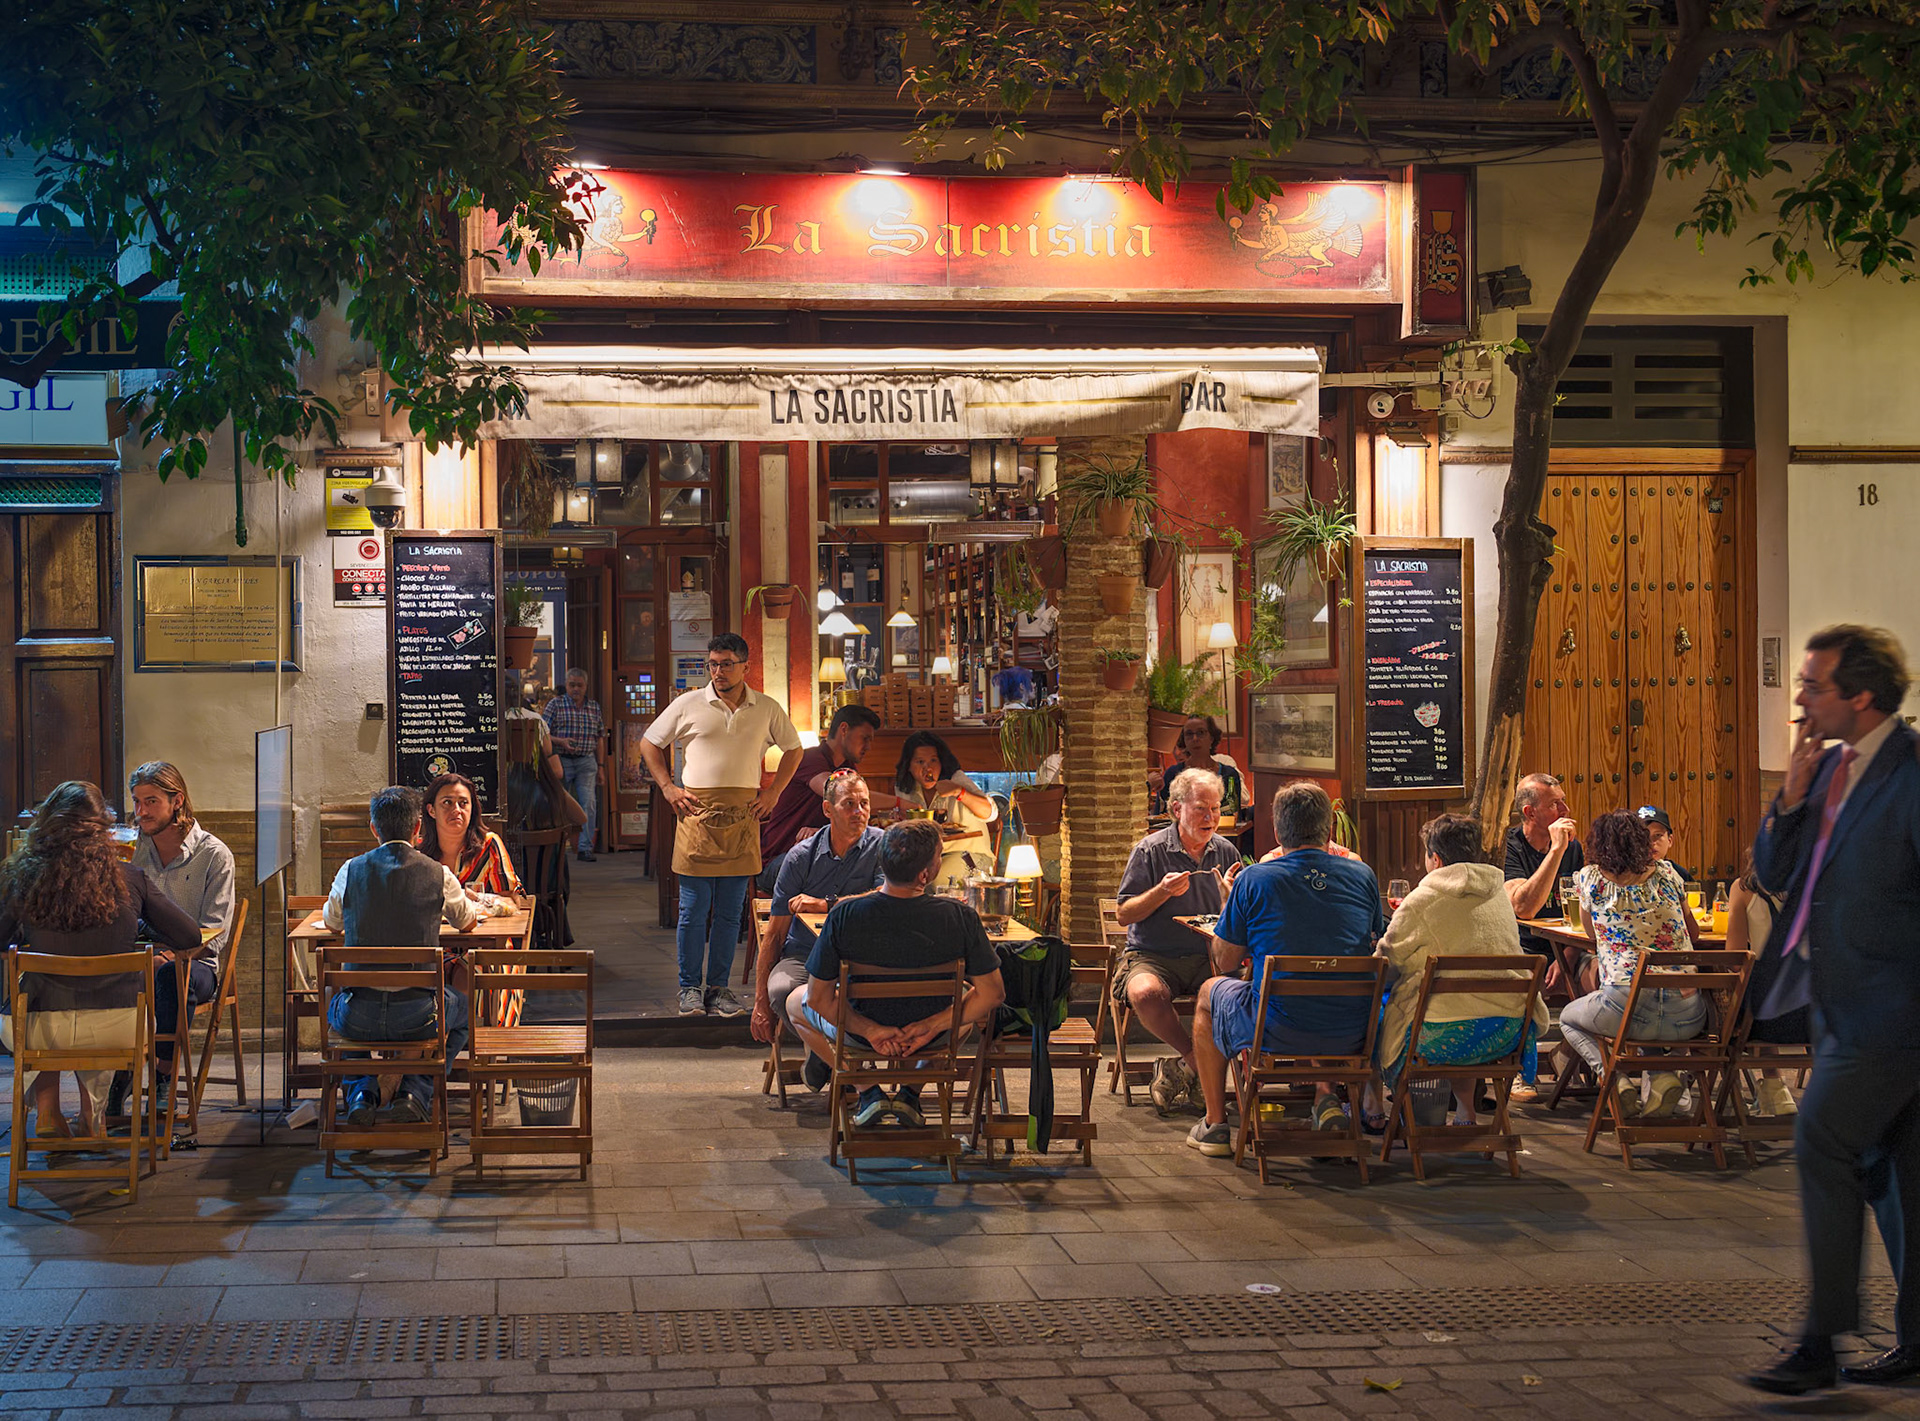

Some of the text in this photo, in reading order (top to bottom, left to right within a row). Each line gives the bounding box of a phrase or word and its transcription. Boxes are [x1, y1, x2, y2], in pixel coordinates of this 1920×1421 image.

[733, 203, 824, 256] La
[0, 317, 138, 355] EGIL
[770, 383, 958, 424] LA SACRISTÍA
[1180, 381, 1226, 414] BAR
[1858, 484, 1878, 506] 18
[409, 546, 420, 555] LA
[1375, 560, 1386, 571] LA
[402, 626, 428, 634] PLATOS
